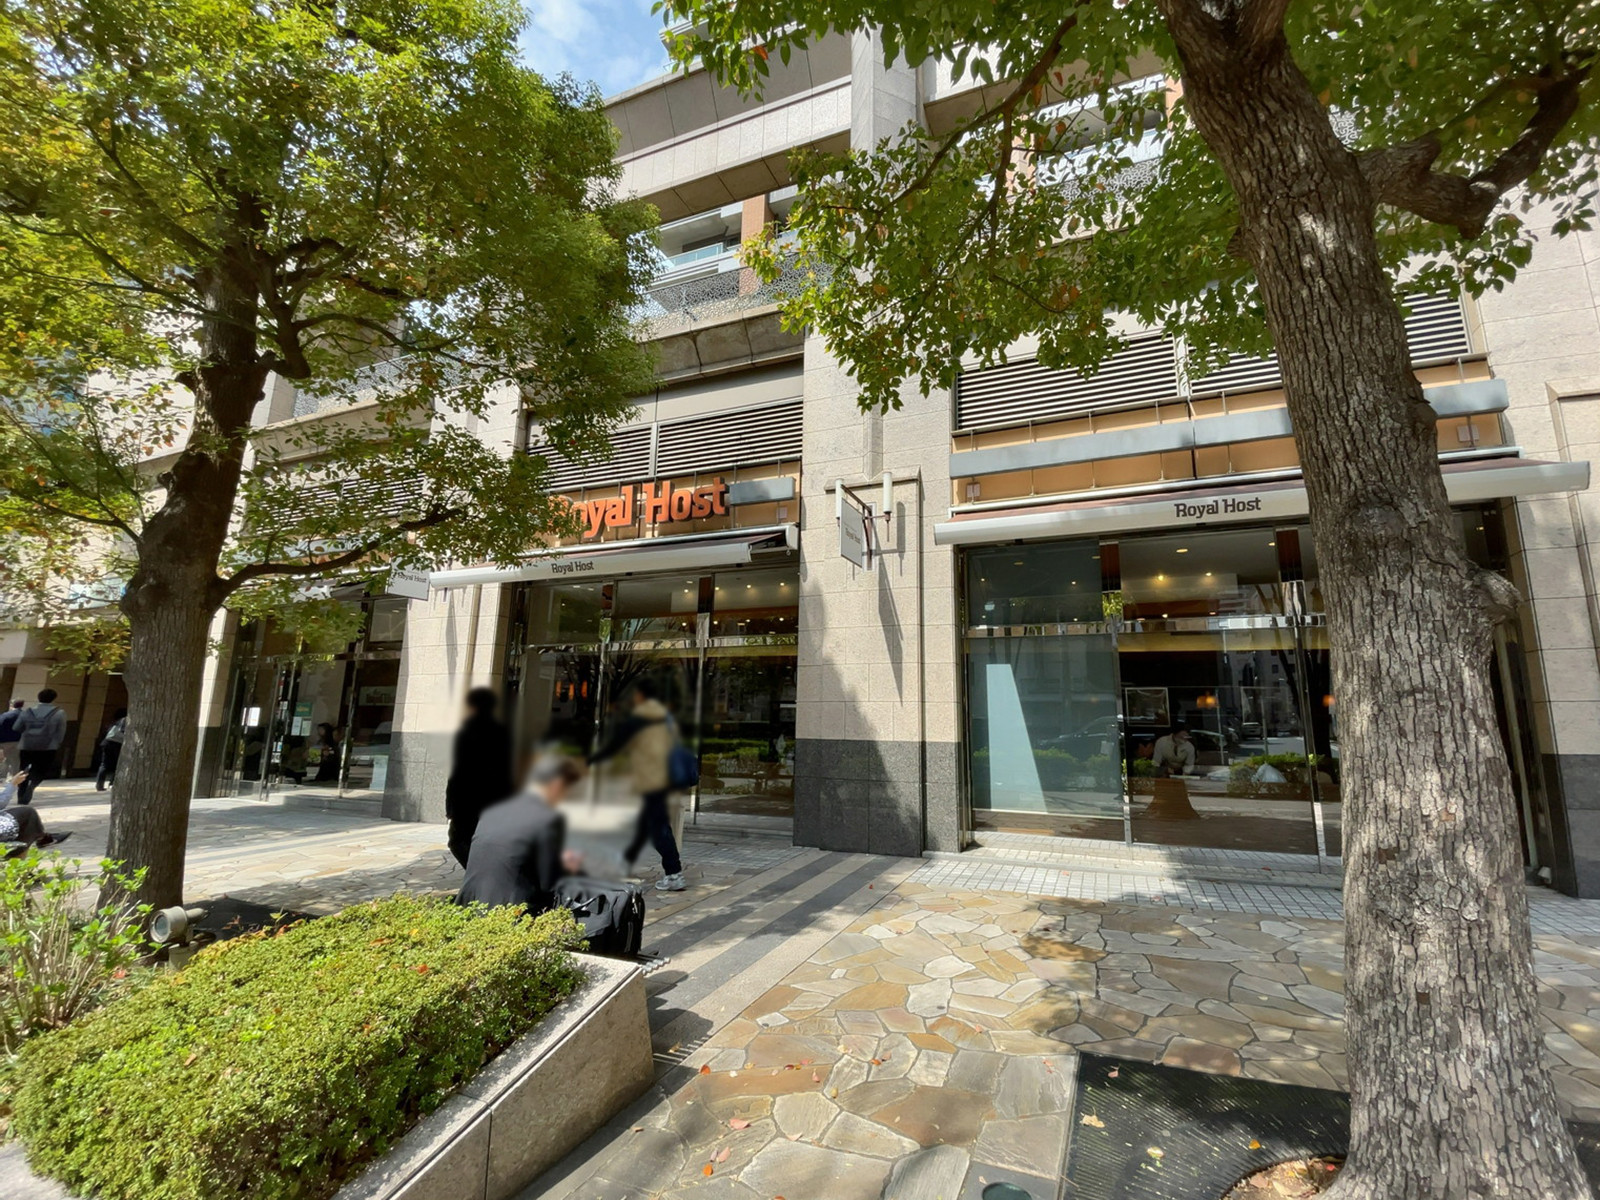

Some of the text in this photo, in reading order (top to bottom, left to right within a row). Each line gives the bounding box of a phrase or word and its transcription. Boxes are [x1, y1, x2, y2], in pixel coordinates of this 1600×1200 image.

[642, 477, 727, 524] Host
[1174, 497, 1261, 519] Royal Host
[551, 561, 594, 575] Royal Host
